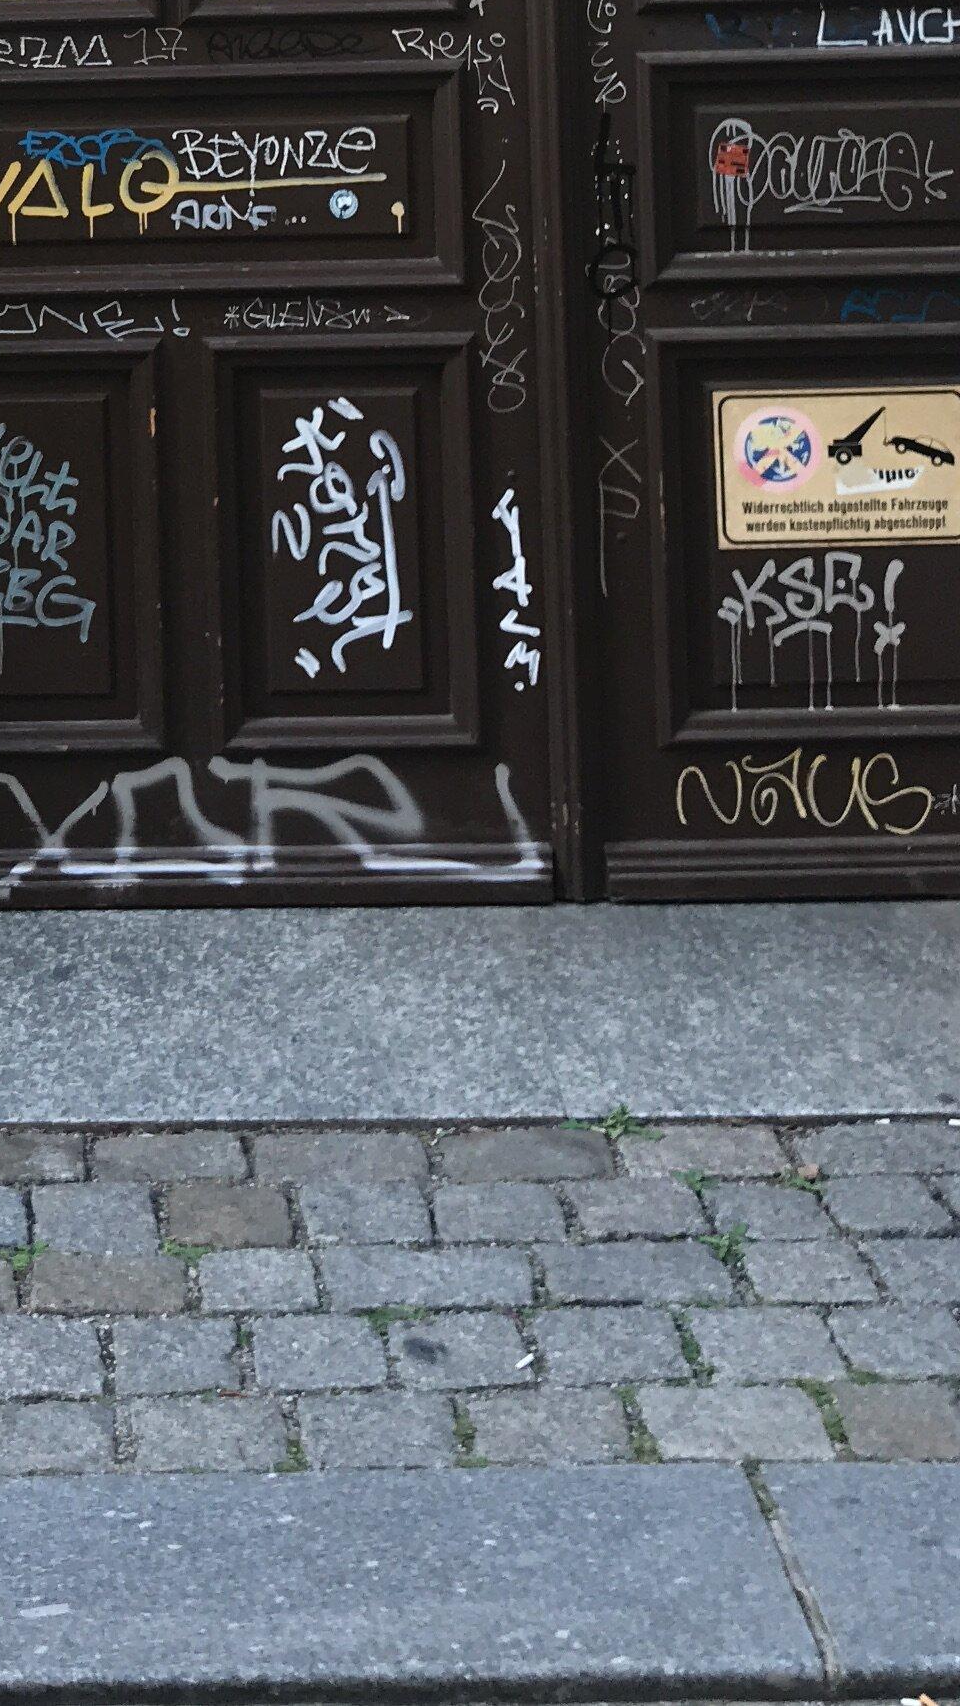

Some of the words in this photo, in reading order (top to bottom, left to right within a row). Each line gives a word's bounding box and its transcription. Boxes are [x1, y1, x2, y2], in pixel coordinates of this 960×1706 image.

[741, 499, 825, 514] Widerrechtlich
[827, 498, 888, 515] abgestellte
[891, 497, 949, 513] Fahrzeuge
[746, 518, 787, 533] werden
[789, 517, 871, 533] kostenpflichtig
[874, 515, 947, 532] abgeschleppt
